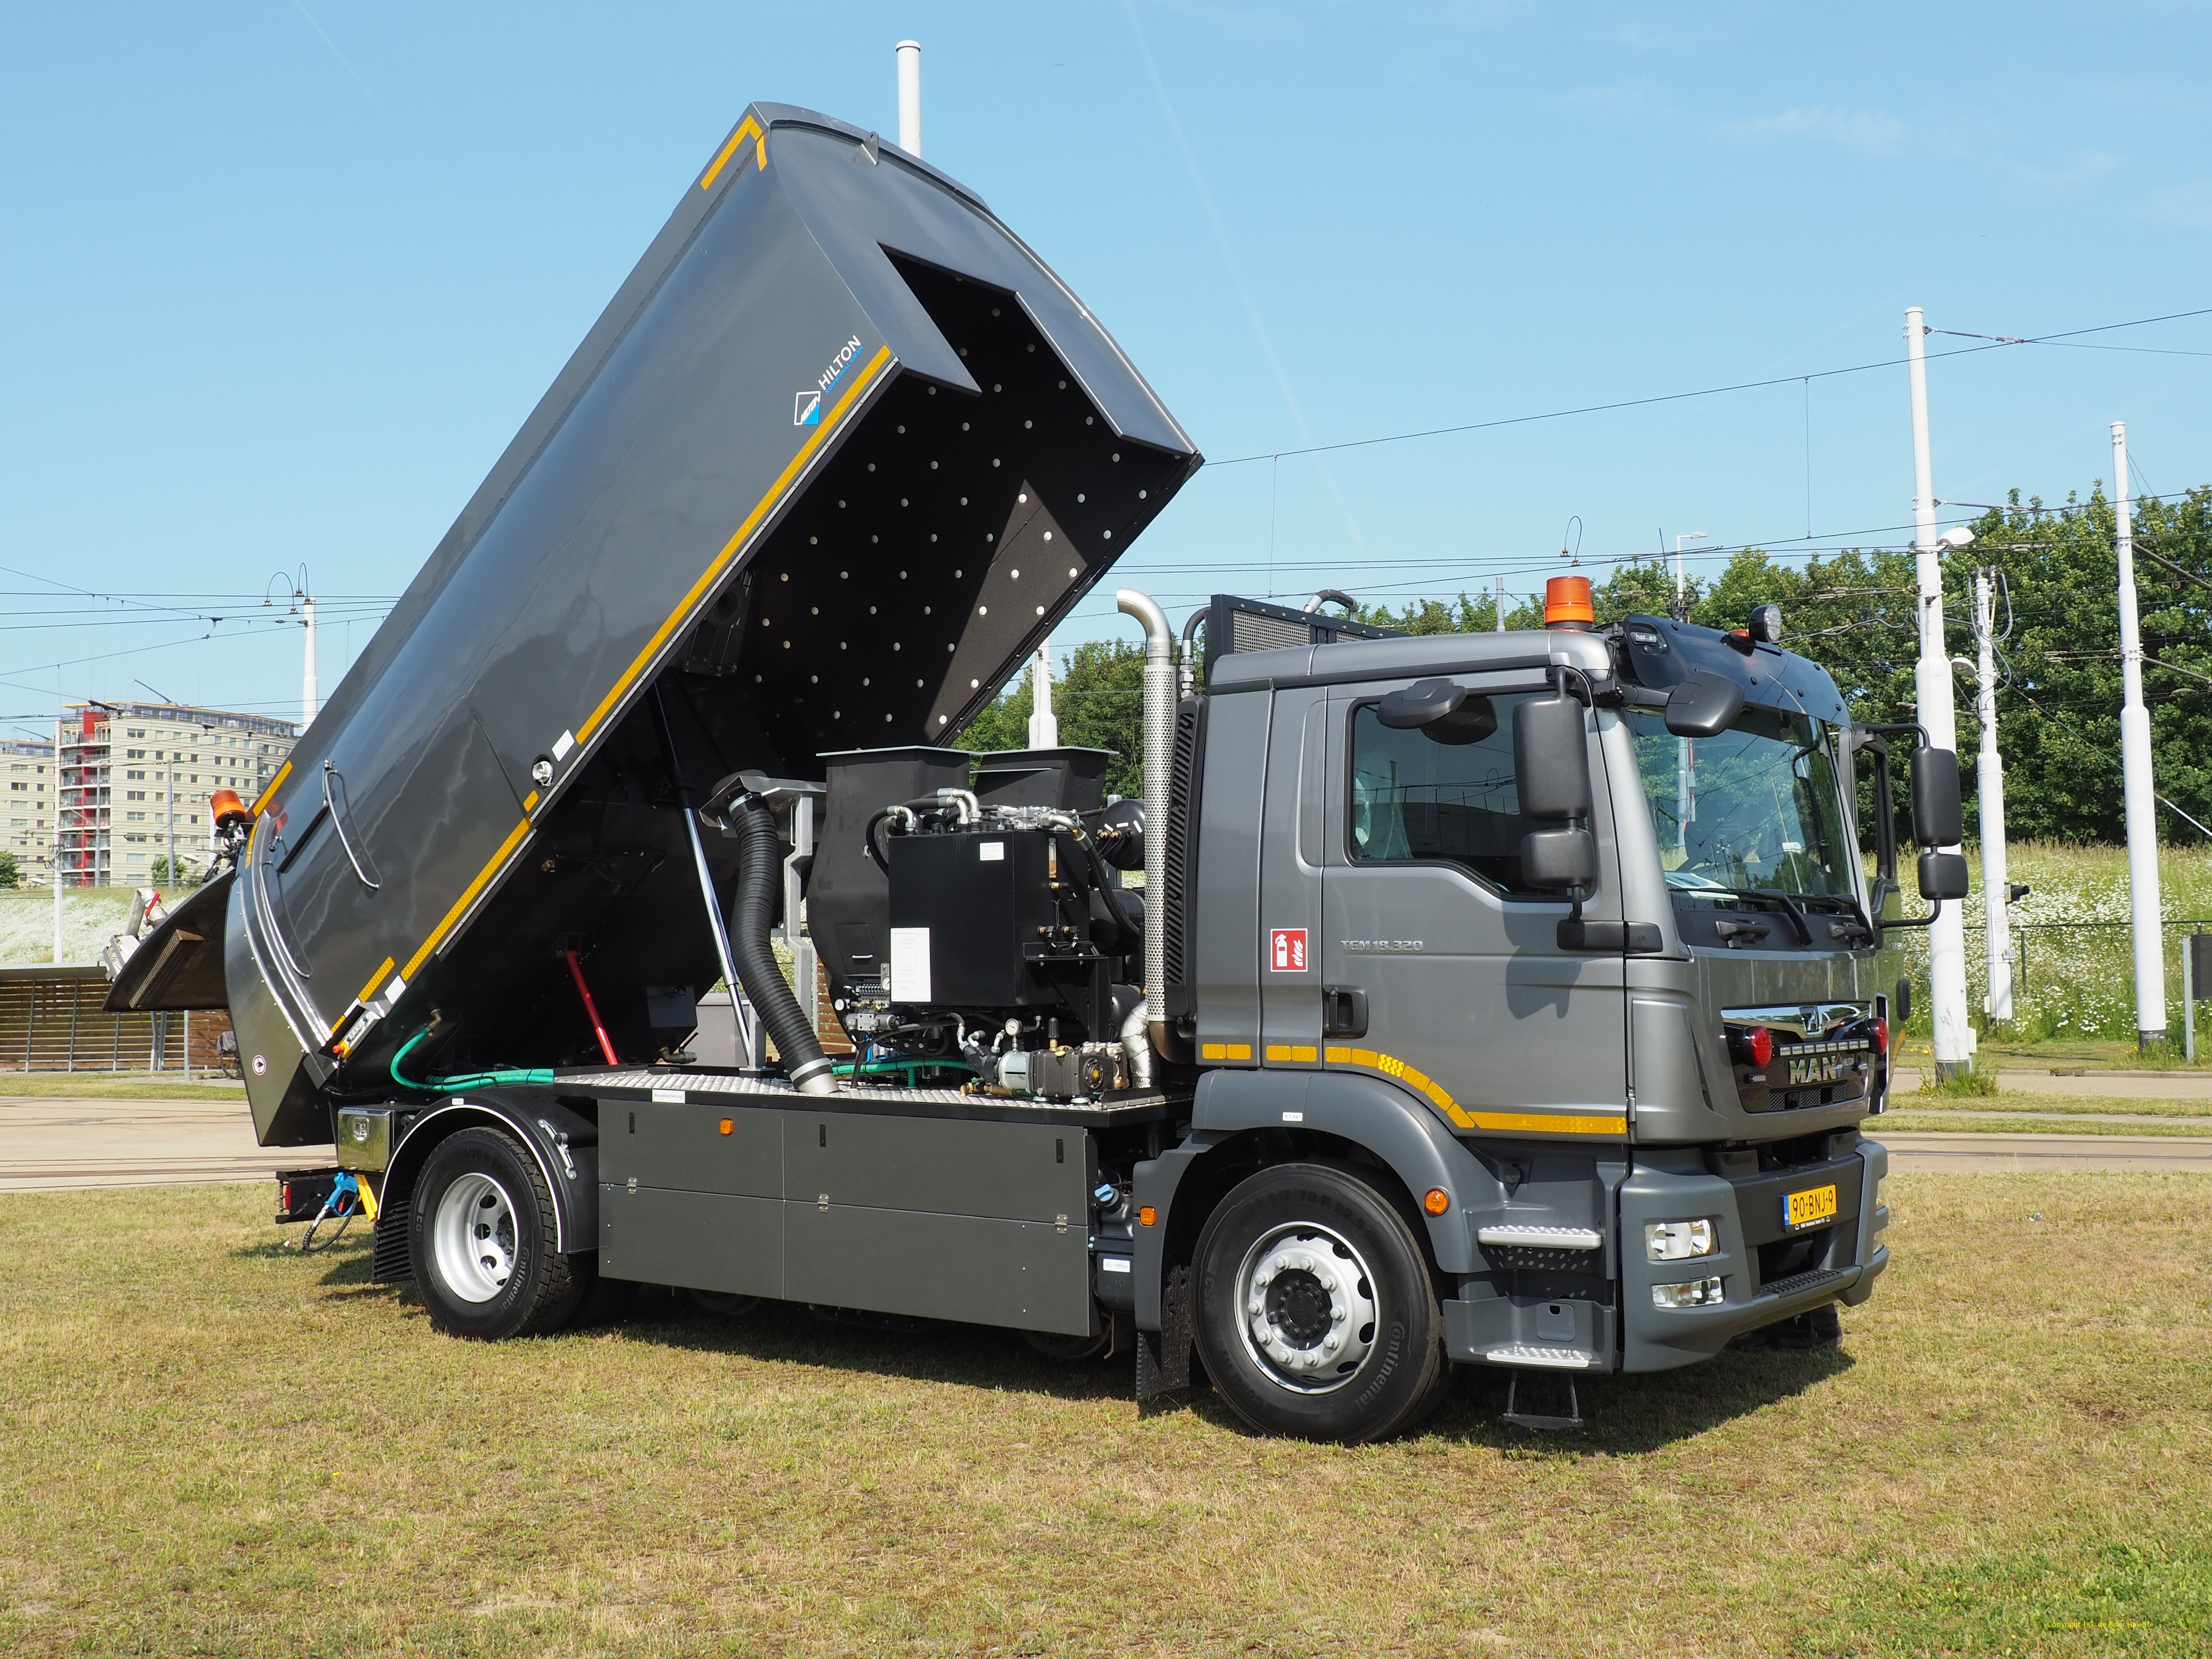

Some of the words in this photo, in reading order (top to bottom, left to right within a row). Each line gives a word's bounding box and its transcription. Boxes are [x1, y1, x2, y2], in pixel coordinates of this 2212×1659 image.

[818, 335, 861, 391] HILTON
[825, 362, 851, 395] KOMMUNAL
[849, 345, 864, 363] GMBH
[1340, 940, 1370, 951] TGM
[1372, 940, 1423, 952] 18.320
[1788, 1055, 1837, 1085] MAN
[1792, 1189, 1833, 1220] 90-BNJ-9
[500, 1246, 529, 1314] Continental
[1354, 1321, 1405, 1412] Continental
